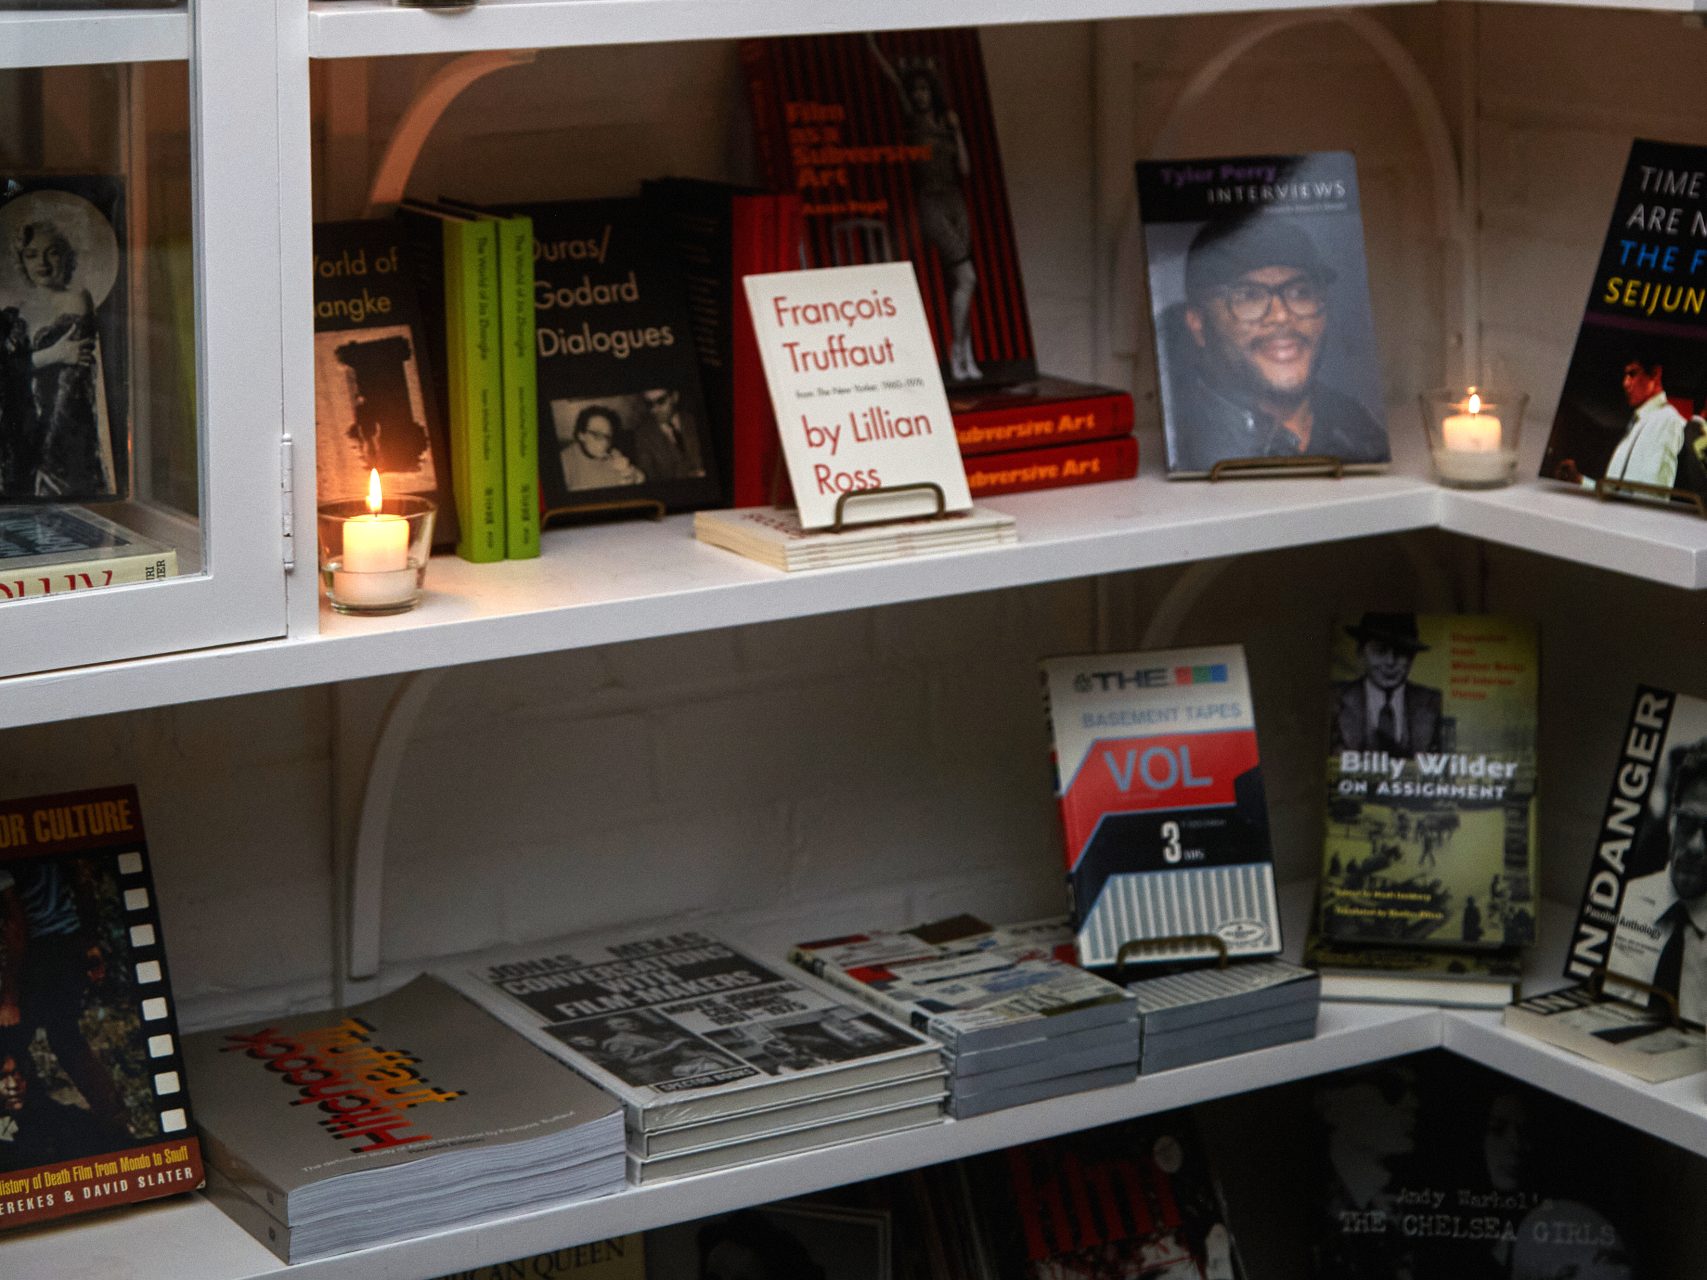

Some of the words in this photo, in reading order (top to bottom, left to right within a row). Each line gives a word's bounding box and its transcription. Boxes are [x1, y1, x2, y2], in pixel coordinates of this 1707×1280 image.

[1206, 179, 1347, 205] INTERVIEWS
[1640, 165, 1705, 199] TIME
[1626, 202, 1680, 236] ARE
[314, 248, 367, 278] orld
[374, 245, 398, 273] of
[1620, 239, 1680, 272] THE
[316, 287, 392, 324] angke
[534, 270, 640, 311] Godard
[772, 290, 897, 329] François
[1604, 276, 1706, 316] SEIJUN
[537, 320, 676, 360] Dialogues
[782, 334, 895, 374] Truffaut
[801, 415, 841, 456] by
[849, 406, 933, 444] Lillian
[958, 422, 1055, 446] ubversive
[1058, 413, 1096, 432] Art
[813, 463, 882, 496] Ross
[967, 464, 1060, 489] ubversive
[1062, 457, 1101, 477] Art
[1081, 707, 1179, 729] BASEMENT
[1185, 702, 1242, 722] TAPES
[1102, 745, 1214, 793] VOL
[1340, 750, 1406, 780] Billy
[1415, 752, 1519, 780] Wilder
[1337, 778, 1368, 796] ON
[1375, 780, 1507, 800] ASSIGNMENT
[1588, 690, 1670, 912] DANGER
[32, 798, 135, 845] CULTURE
[1160, 820, 1183, 864] 3
[1619, 916, 1663, 940] Anthology
[501, 942, 736, 996] CONVERSATIONS
[1568, 922, 1610, 979] IN
[554, 970, 763, 1018] FILM-MAKERS
[597, 969, 688, 993] WITH
[218, 1027, 433, 1154] Hitchcock
[32, 1172, 43, 1190] of
[44, 1169, 72, 1187] Death
[72, 1164, 93, 1183] Film
[94, 1161, 119, 1179] from
[119, 1153, 152, 1172] Mondo
[153, 1151, 164, 1166] to
[165, 1144, 190, 1165] Snuff
[63, 1189, 75, 1204] &
[82, 1178, 129, 1200] DAVID
[137, 1165, 195, 1189] SLATER
[1338, 1209, 1387, 1234] THE
[1402, 1213, 1518, 1242] CHELSEA
[1532, 1221, 1617, 1246] GIRLS
